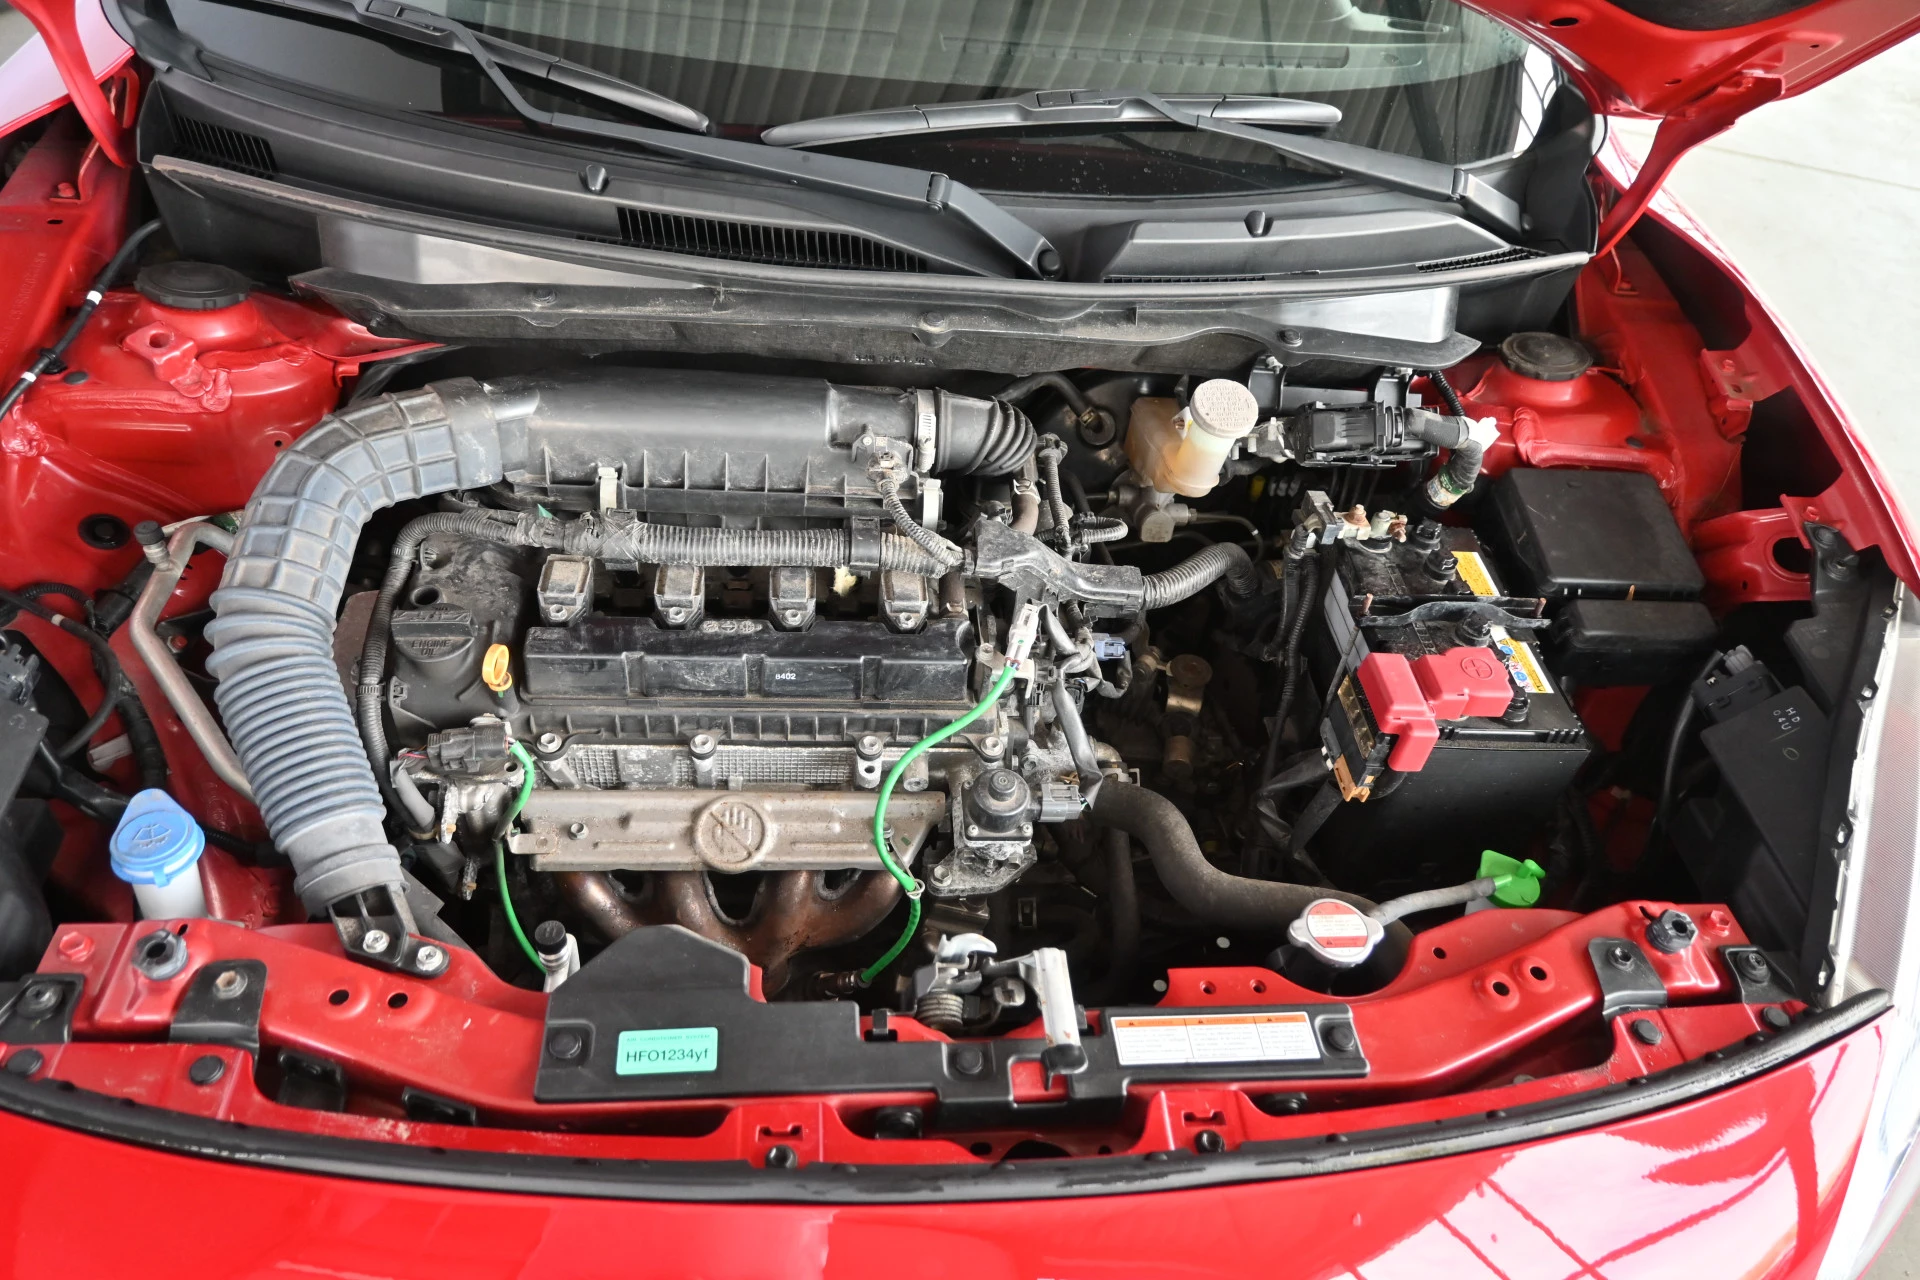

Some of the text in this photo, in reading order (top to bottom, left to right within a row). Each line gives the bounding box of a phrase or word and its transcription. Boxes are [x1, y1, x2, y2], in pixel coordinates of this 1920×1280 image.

[412, 640, 452, 648] ENGINE
[421, 648, 438, 657] OIL
[626, 1048, 709, 1063] HFO1234yf
